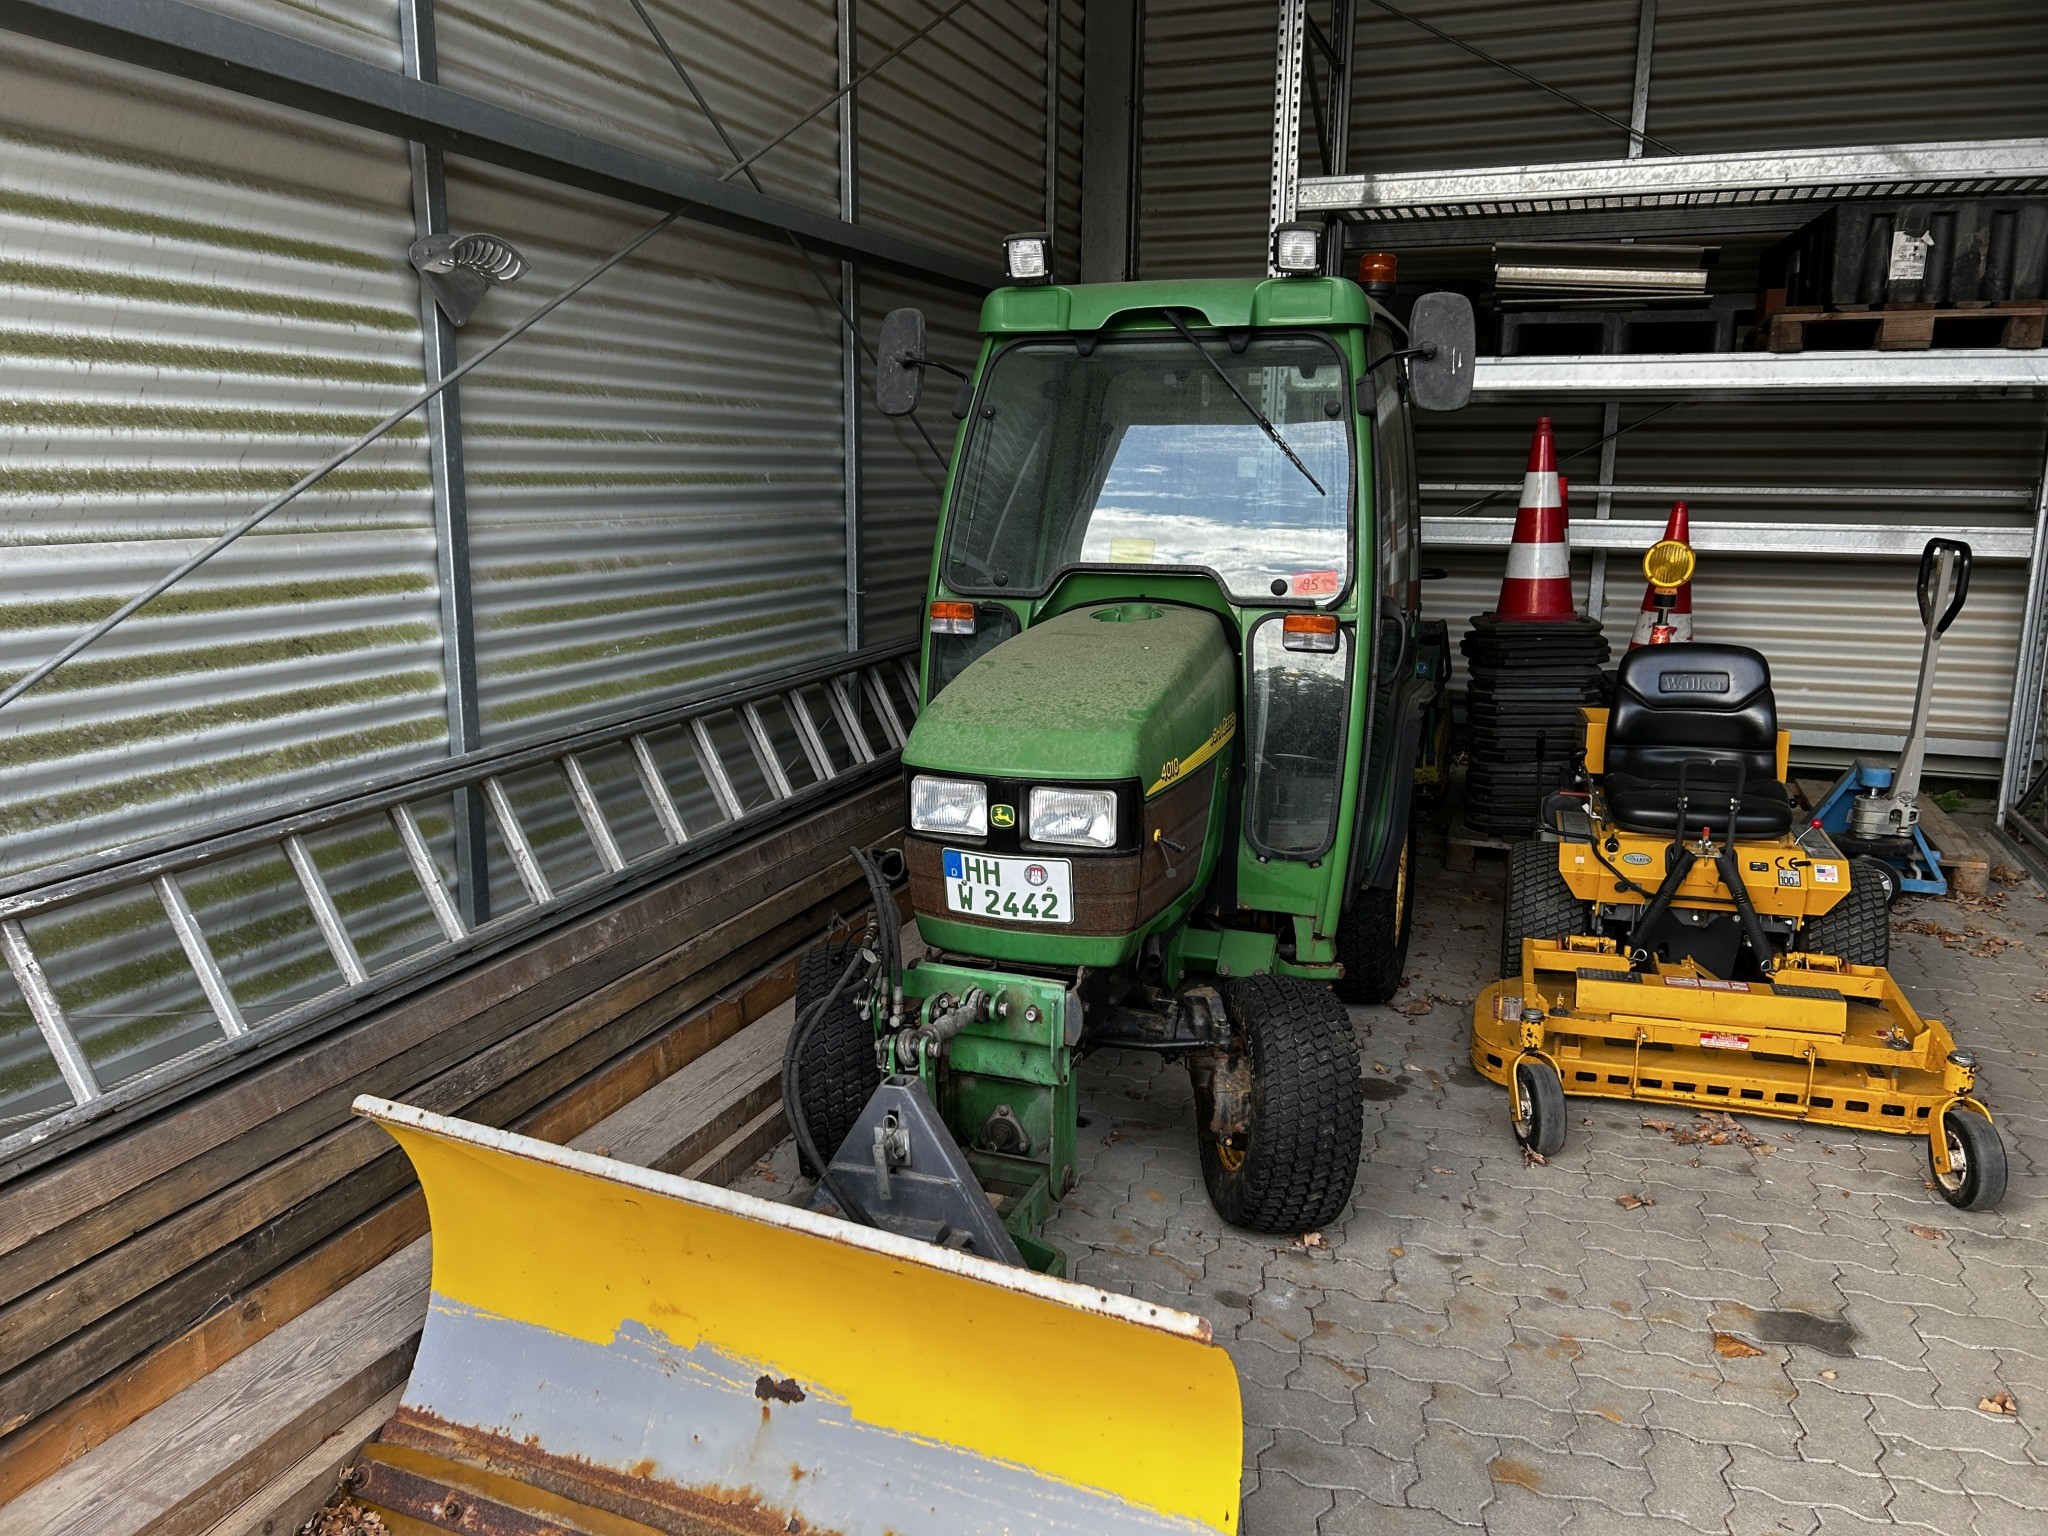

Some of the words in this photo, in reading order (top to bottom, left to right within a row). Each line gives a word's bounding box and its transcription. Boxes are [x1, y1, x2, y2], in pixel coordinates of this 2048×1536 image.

[1302, 578, 1319, 591] 95
[1663, 674, 1726, 690] Walker
[1160, 757, 1179, 781] 4010
[951, 867, 958, 877] D
[964, 856, 1001, 887] HH
[1780, 876, 1795, 886] 100
[957, 883, 973, 911] W
[984, 889, 1059, 919] 2442
